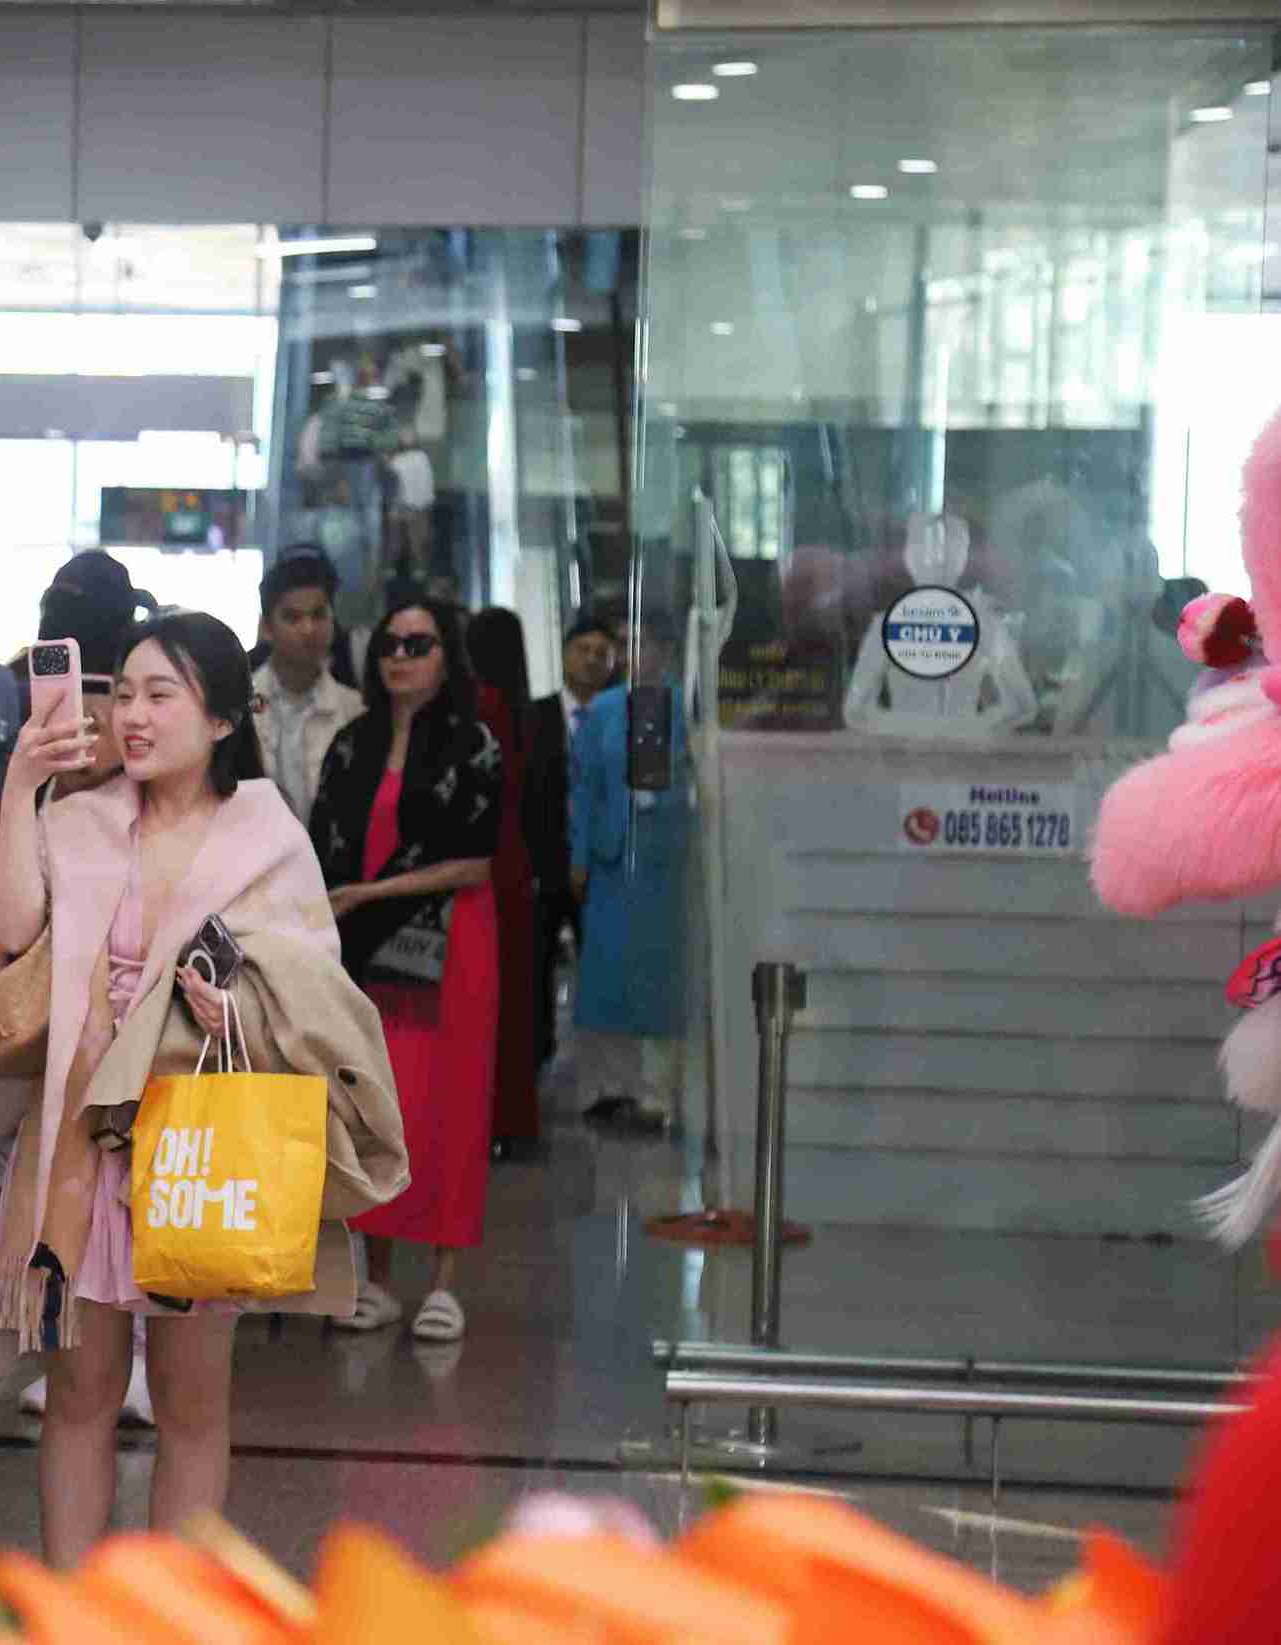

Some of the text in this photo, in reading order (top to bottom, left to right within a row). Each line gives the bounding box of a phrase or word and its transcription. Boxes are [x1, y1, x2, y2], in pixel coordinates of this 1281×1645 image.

[944, 809, 1071, 848] 085 865 1278
[152, 1126, 215, 1177] OH!
[147, 1178, 258, 1231] SOME
